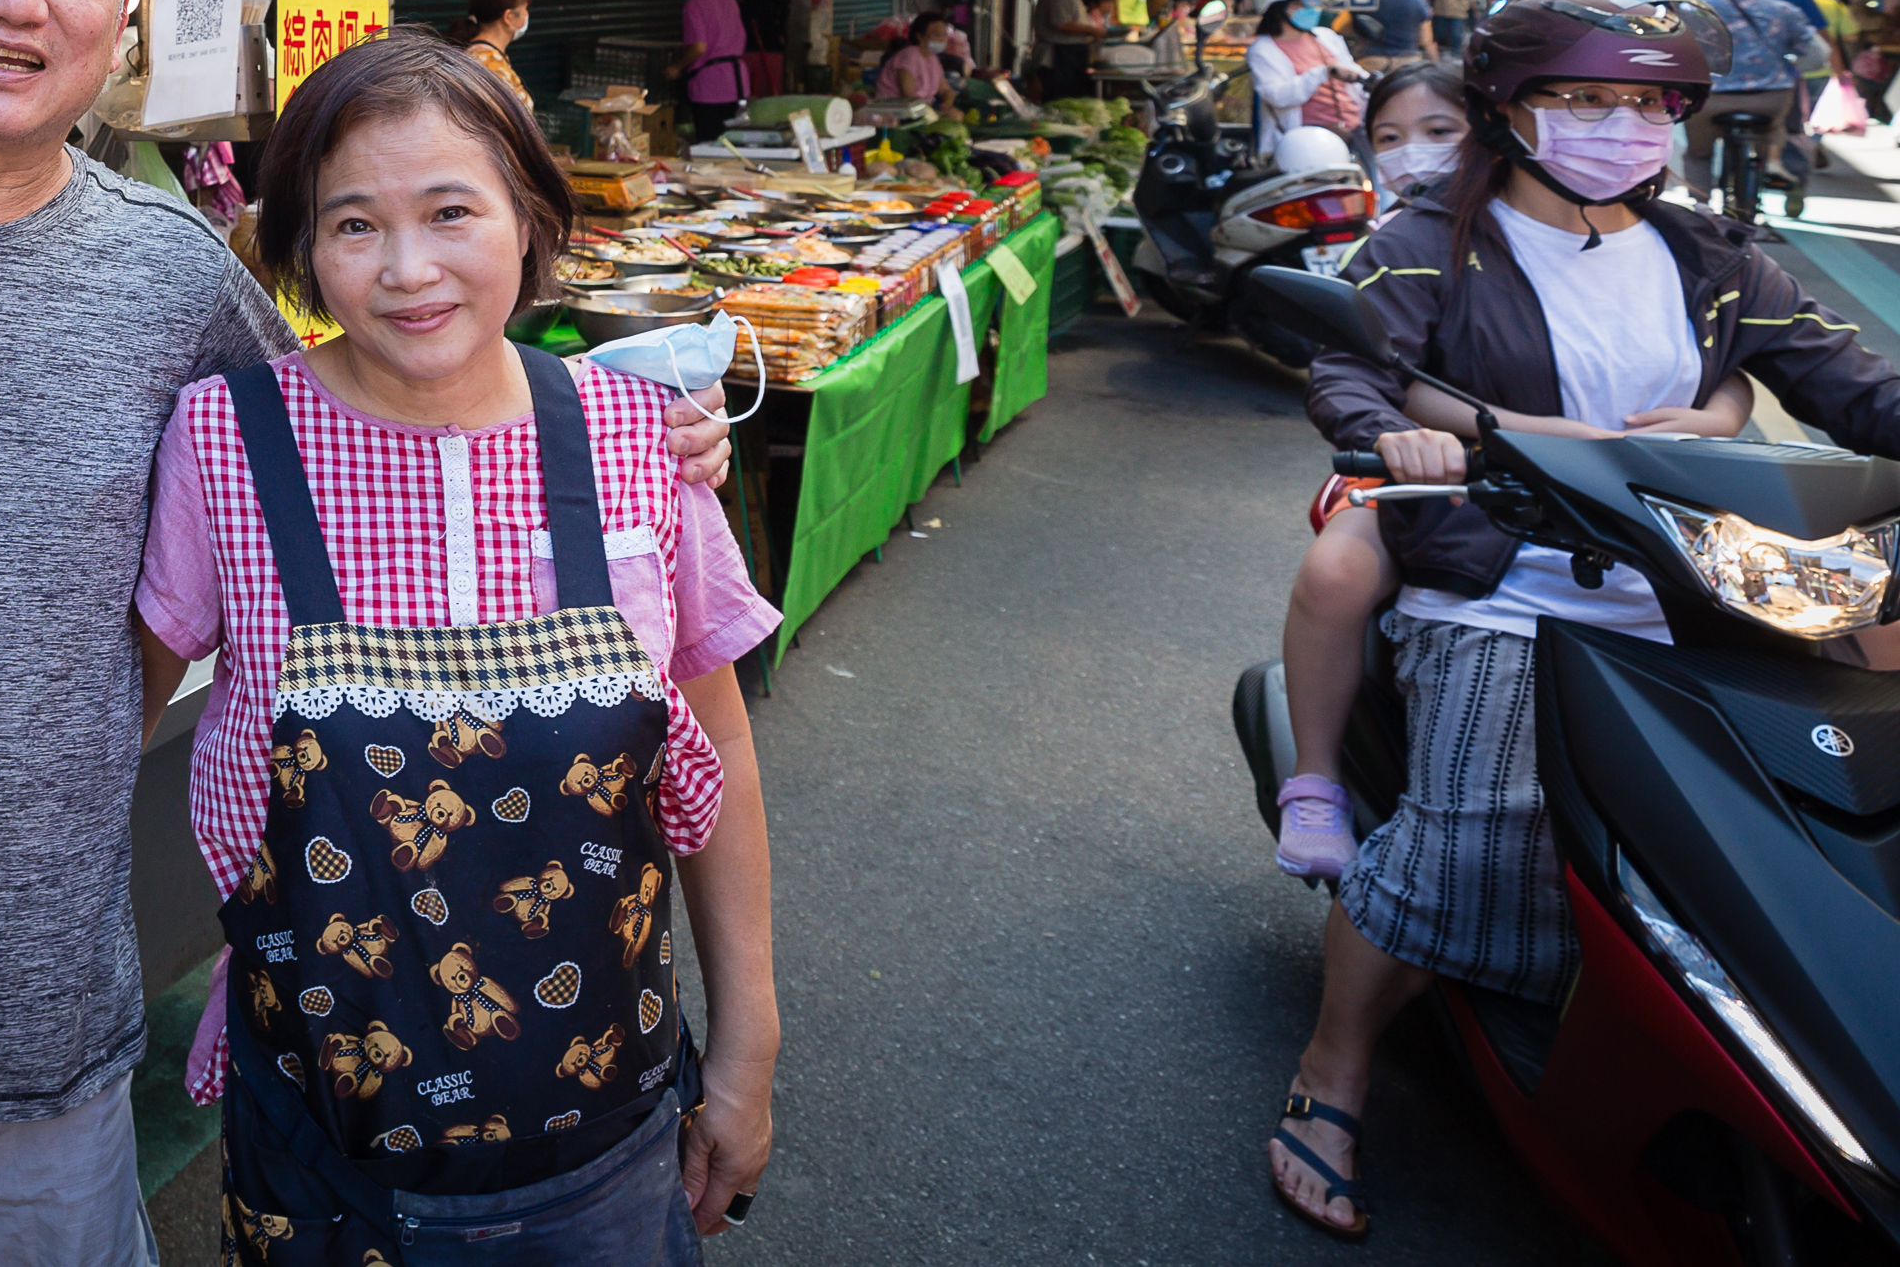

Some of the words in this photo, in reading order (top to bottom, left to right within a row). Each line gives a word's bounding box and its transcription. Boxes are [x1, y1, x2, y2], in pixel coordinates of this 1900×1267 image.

[580, 841, 623, 864] CLASSIC
[583, 858, 617, 879] BEAR
[256, 929, 295, 950] CLASSIC
[265, 946, 298, 963] BEAR
[417, 1069, 473, 1096] CLASSIC
[431, 1086, 476, 1107] BEAR
